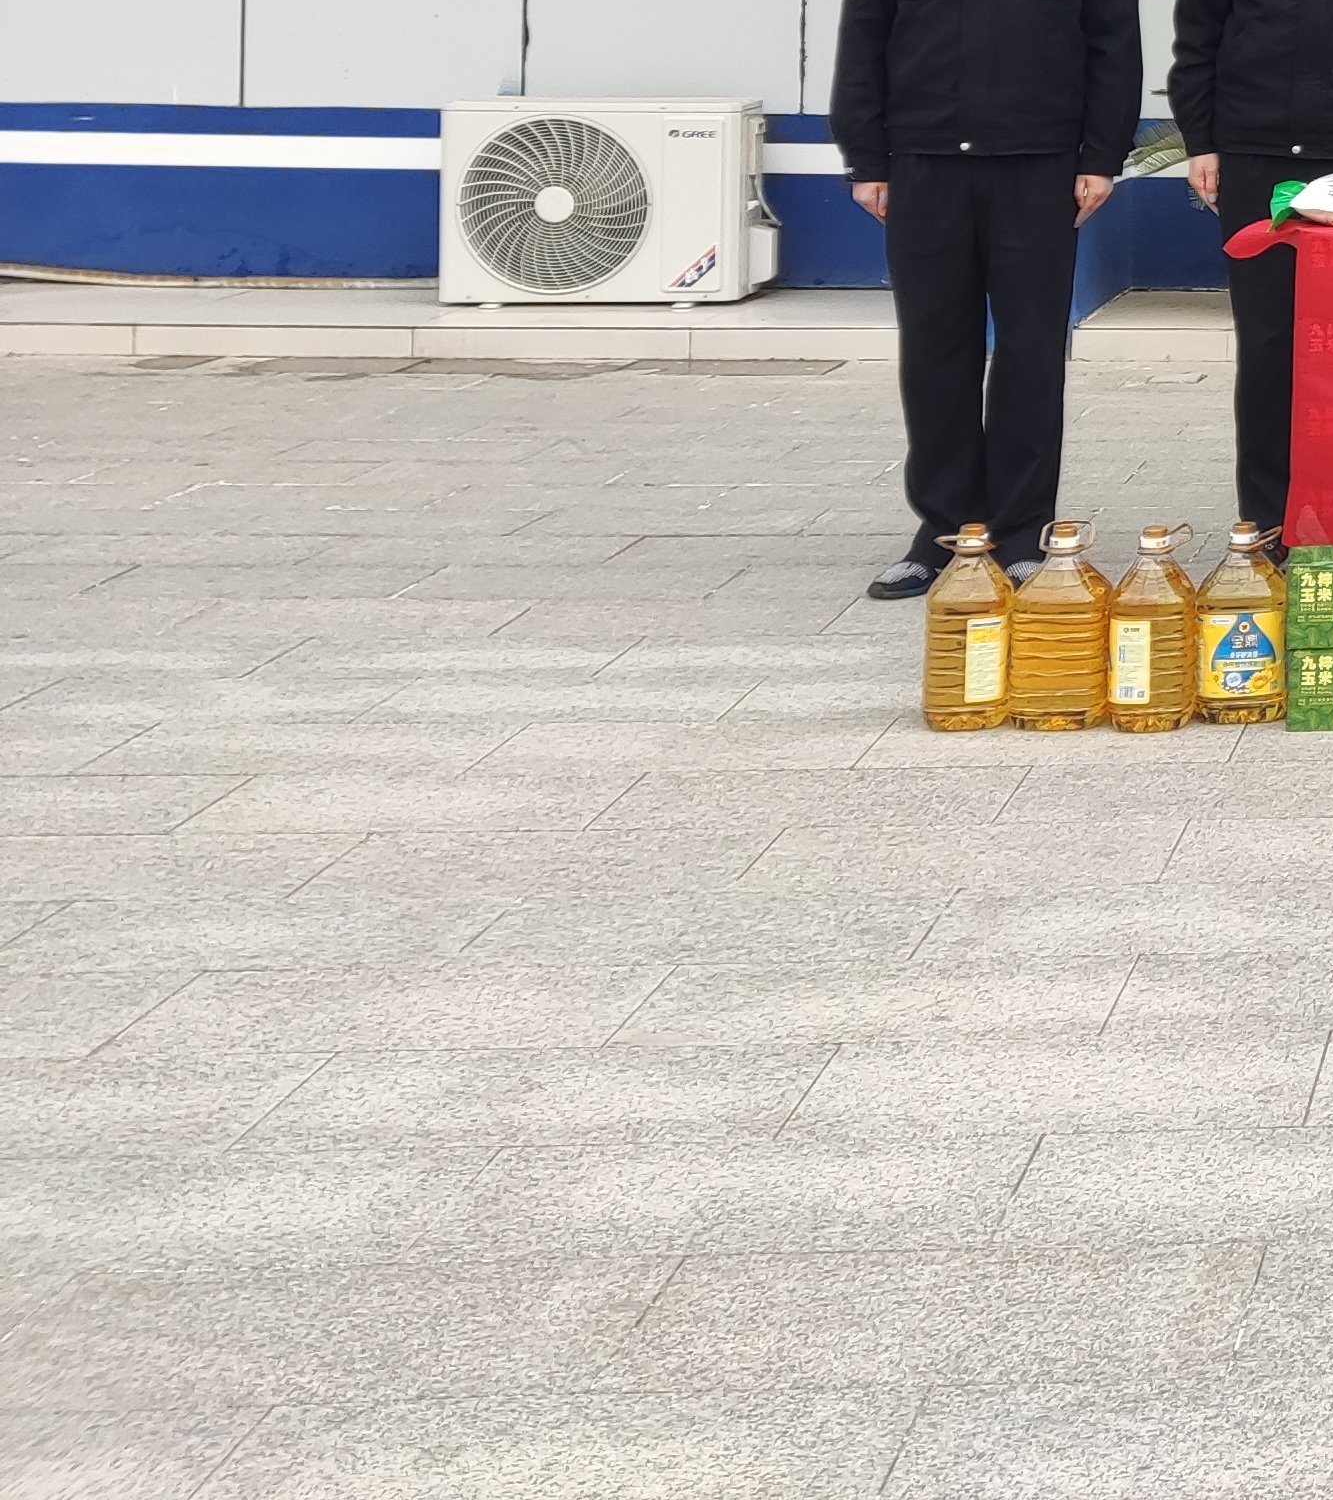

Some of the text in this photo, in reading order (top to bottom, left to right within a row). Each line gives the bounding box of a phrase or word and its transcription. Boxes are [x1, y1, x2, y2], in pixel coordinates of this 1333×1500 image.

[681, 130, 717, 139] GREE
[1300, 587, 1333, 603] 玉米
[1301, 670, 1333, 686] 玉米
